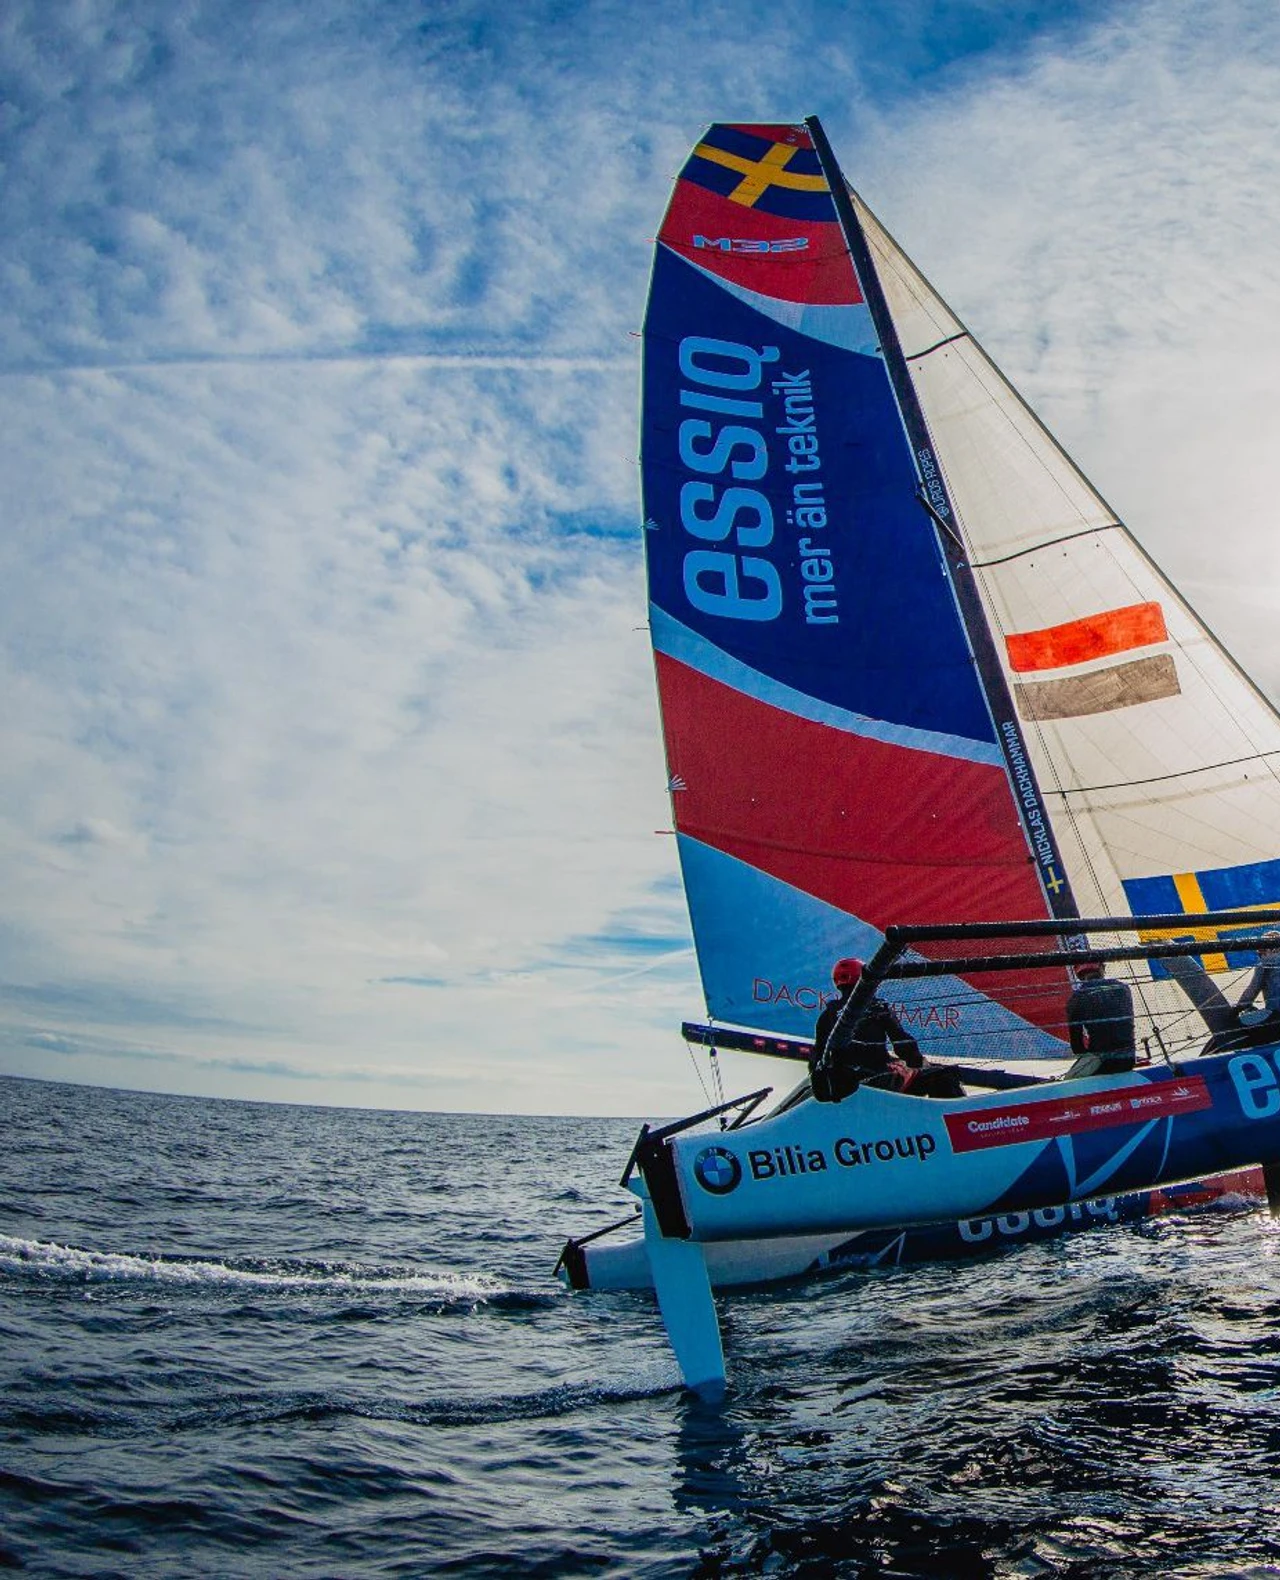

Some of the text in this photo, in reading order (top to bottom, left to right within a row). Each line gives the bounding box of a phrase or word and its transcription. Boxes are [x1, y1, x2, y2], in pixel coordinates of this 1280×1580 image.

[693, 234, 809, 253] M32
[771, 369, 839, 625] mer än teknik
[1002, 720, 1056, 866] NICKLAS DACKHAMMAR
[967, 1115, 1030, 1133] Candidate
[748, 1132, 936, 1180] Bilia Group
